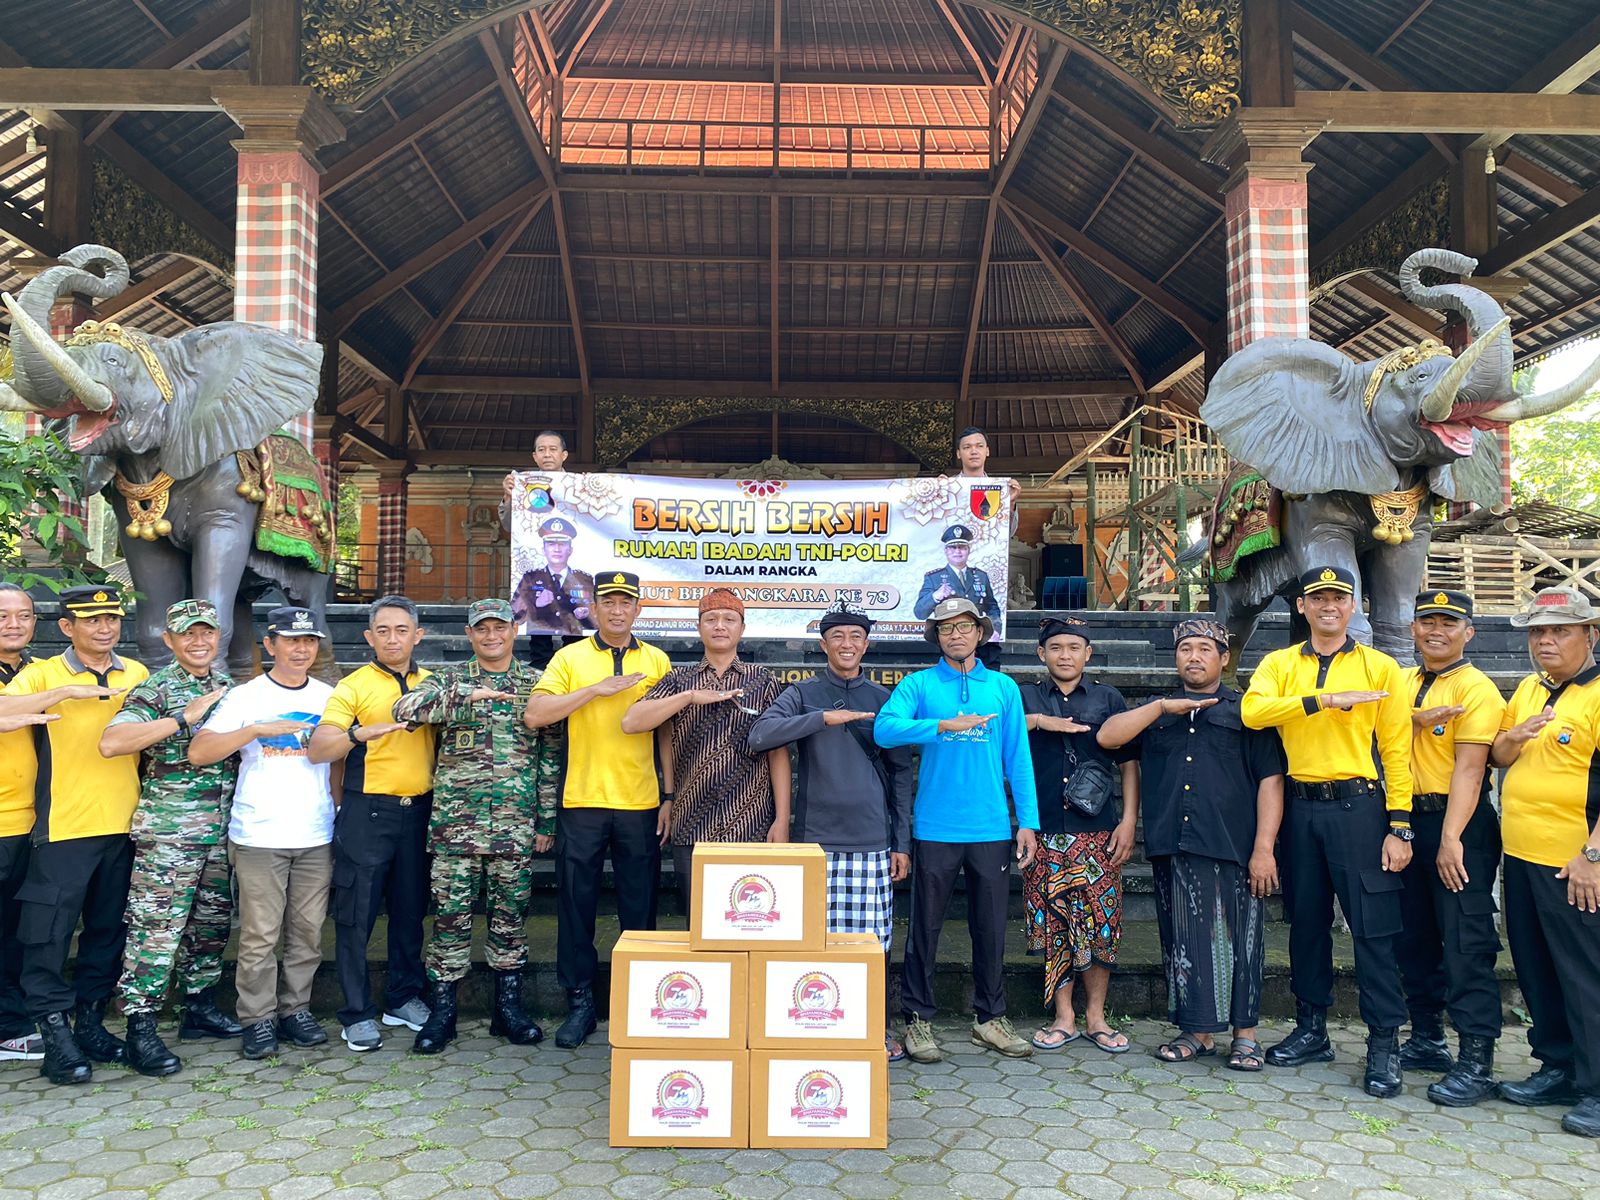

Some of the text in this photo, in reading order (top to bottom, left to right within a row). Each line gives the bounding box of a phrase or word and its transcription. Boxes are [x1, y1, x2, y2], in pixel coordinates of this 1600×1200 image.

[633, 498, 889, 538] BERSIH BERSIH
[614, 539, 908, 561] RUMAH IBADAH TNI-POLRI
[704, 565, 817, 576] DALAM RANGKA
[678, 586, 831, 602] BHANGKARA
[835, 589, 862, 602] KE
[867, 591, 889, 605] 78
